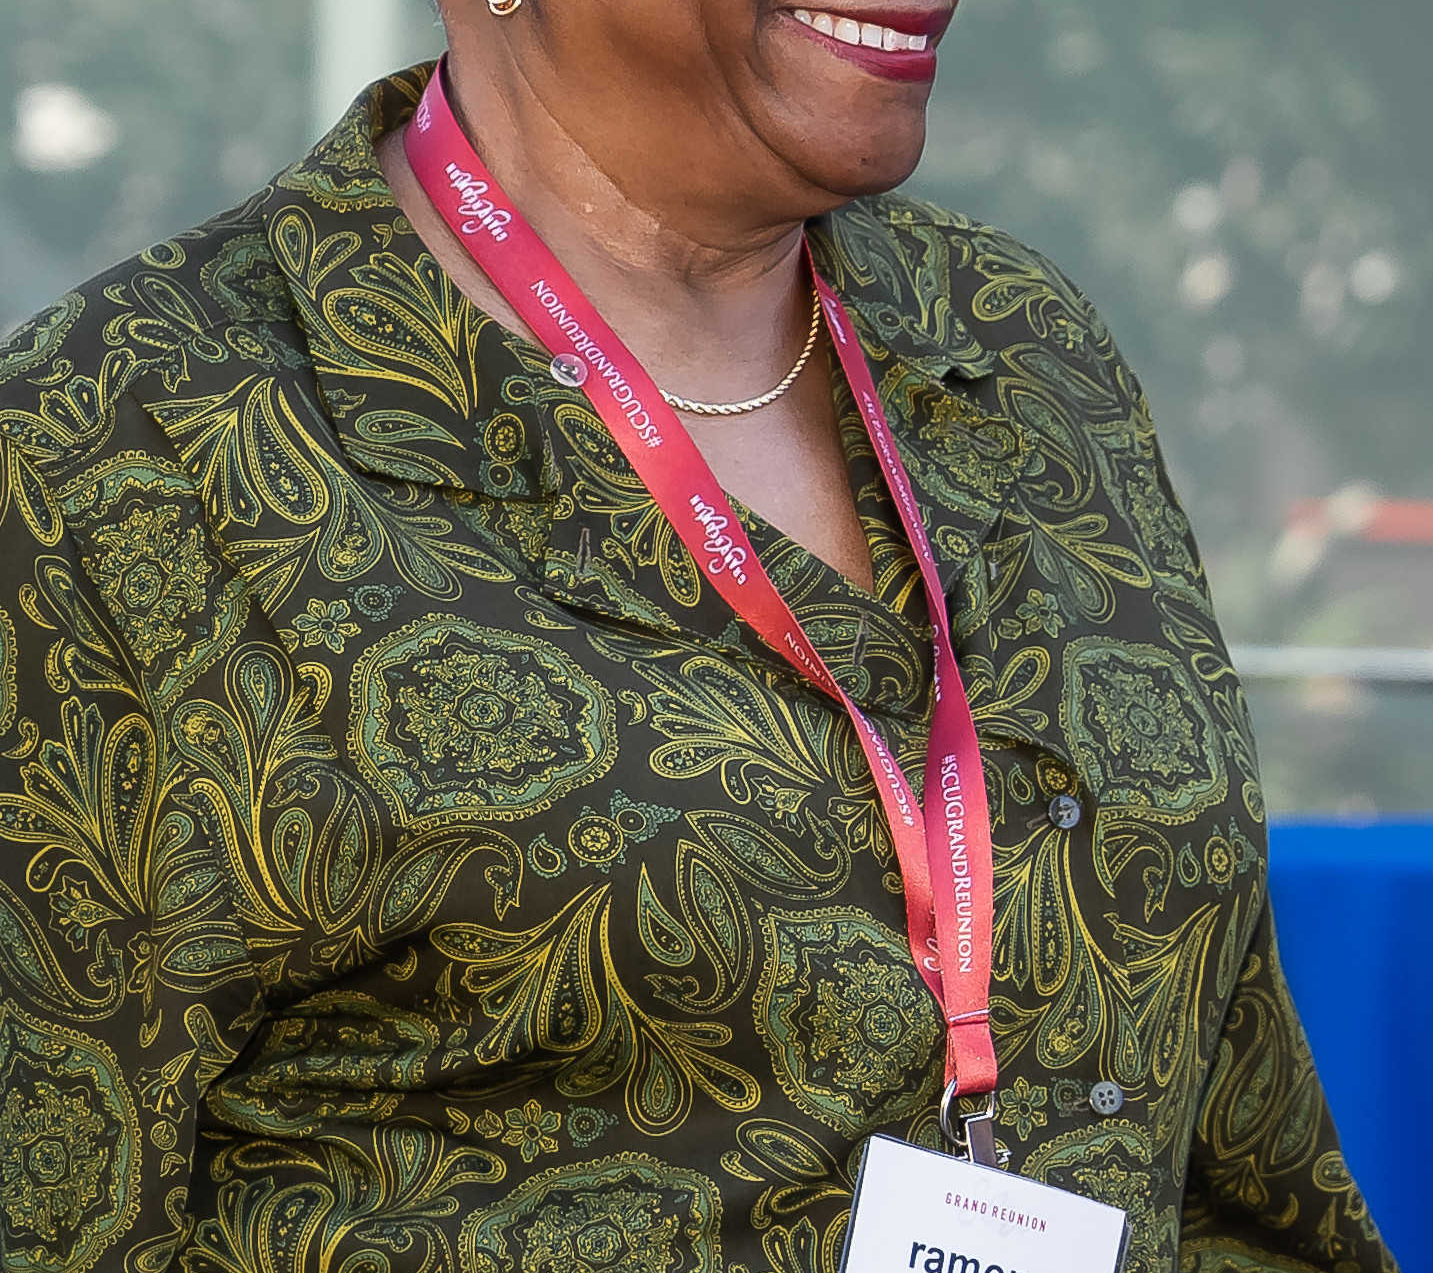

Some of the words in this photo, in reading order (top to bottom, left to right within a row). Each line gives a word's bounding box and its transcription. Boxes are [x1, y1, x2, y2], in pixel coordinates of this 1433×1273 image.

[530, 279, 664, 448] #SCUGRANDREUNION
[940, 754, 973, 974] #SCUGRANDREUNION
[945, 1191, 988, 1215] GRAND
[991, 1204, 1047, 1233] REUNION
